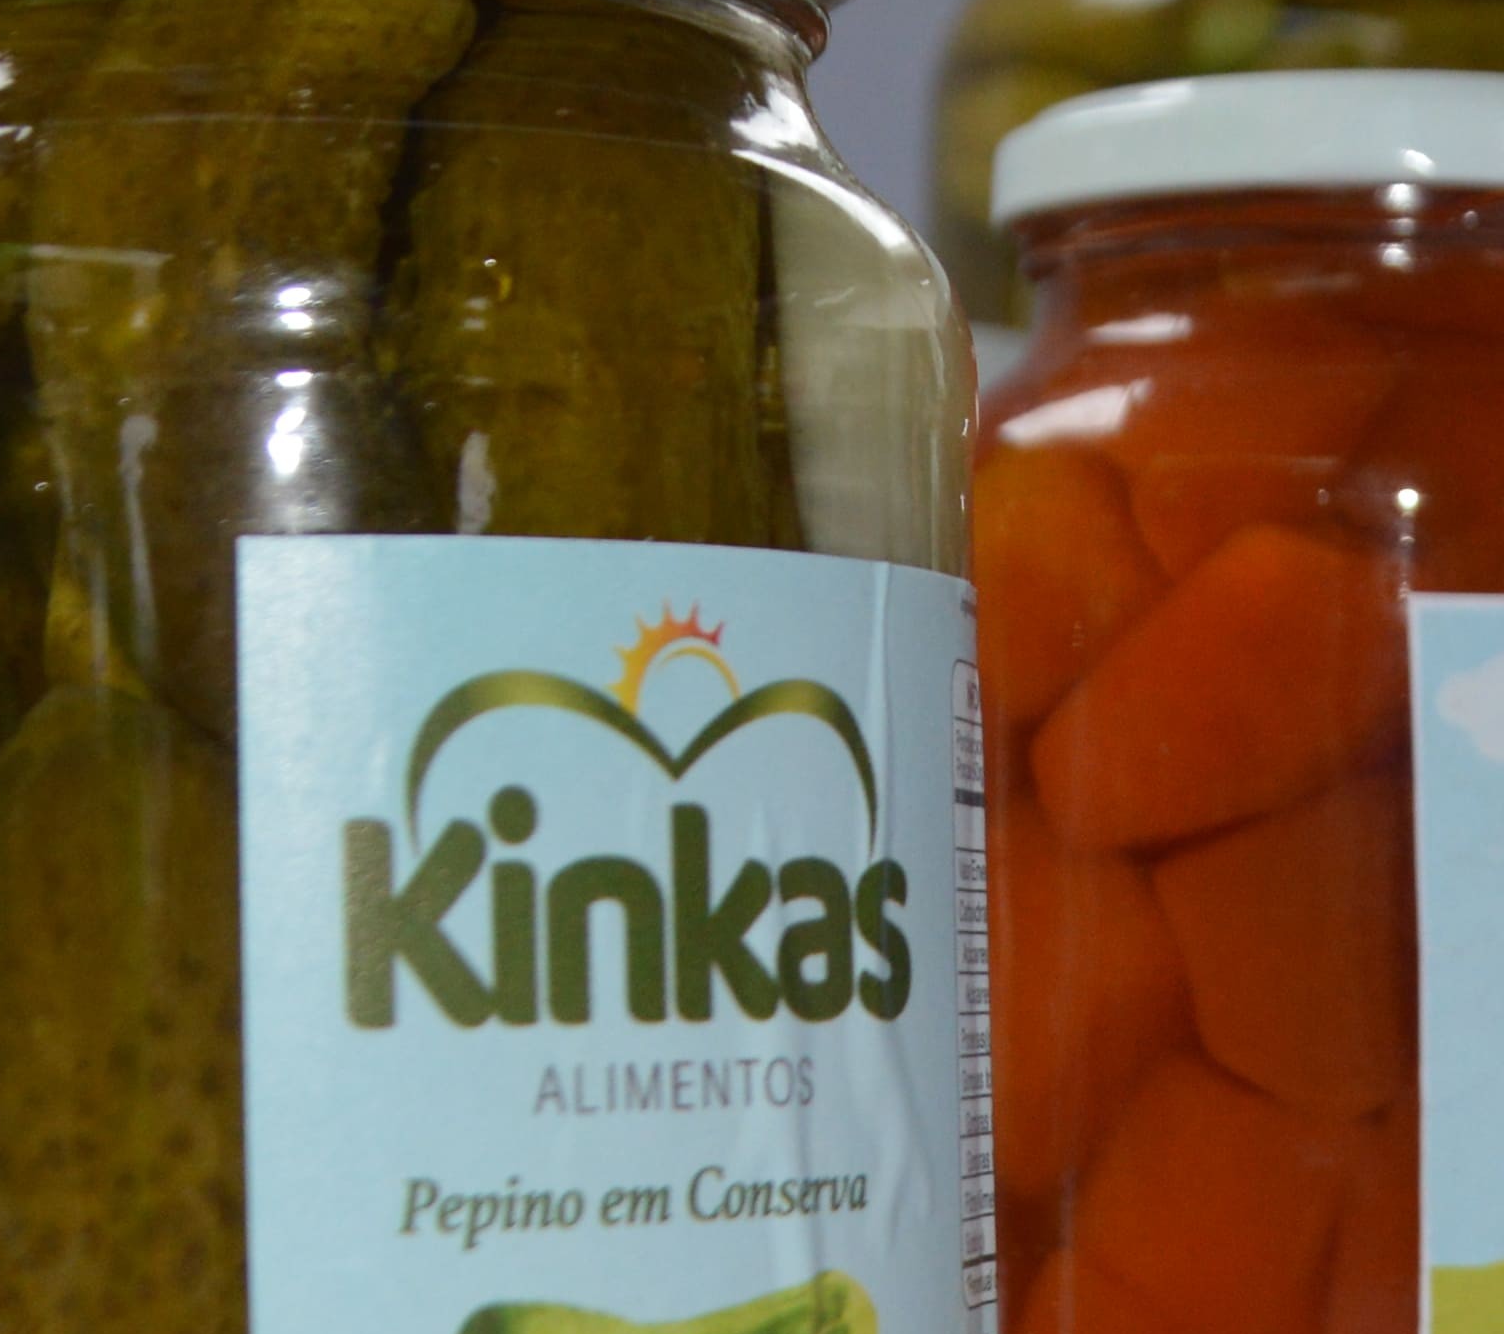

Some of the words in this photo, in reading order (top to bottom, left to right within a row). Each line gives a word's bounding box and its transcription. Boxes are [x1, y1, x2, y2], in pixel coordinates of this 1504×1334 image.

[342, 784, 913, 1030] Kinkas
[532, 1055, 816, 1117] ALIMENTOS
[398, 1176, 585, 1251] Pepino
[599, 1182, 672, 1227] em
[685, 1166, 870, 1224] Conserva
